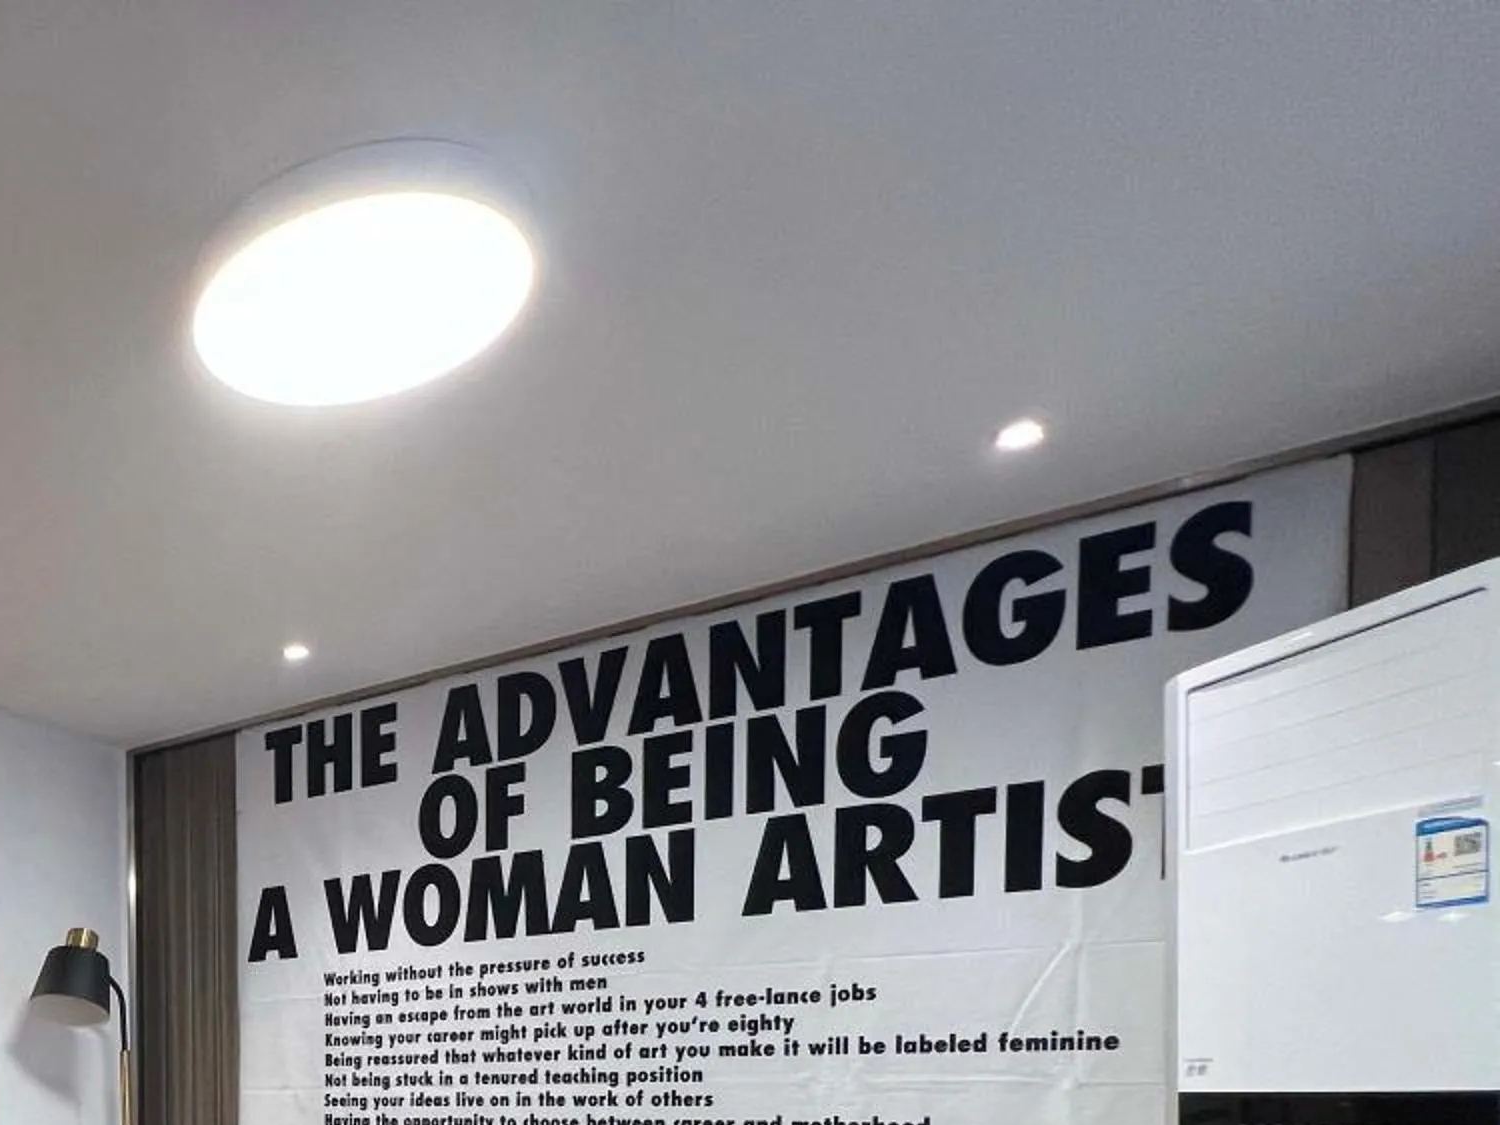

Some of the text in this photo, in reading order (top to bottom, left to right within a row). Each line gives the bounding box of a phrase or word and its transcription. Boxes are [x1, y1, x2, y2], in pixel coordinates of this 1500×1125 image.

[263, 499, 1255, 805] THE ADVANTAGES
[418, 690, 928, 860] OF BEING
[247, 885, 298, 963] A
[323, 827, 695, 955] WOMAN
[323, 951, 646, 987] Working without the pressure of success
[324, 976, 608, 1006] Not having to be in shows with men
[324, 983, 877, 1029] Having an escape from the art world in your 4 free-lance jobs
[324, 1013, 795, 1049] Knowing your career might pick up after you're eighty
[324, 1032, 1120, 1070] Being reassured that whatever kind of art you make it will be labeled feminine
[324, 1065, 704, 1090] Not being stuck in a tenured teaching position
[323, 1089, 714, 1111] Seeing your ideas live on in the work of others
